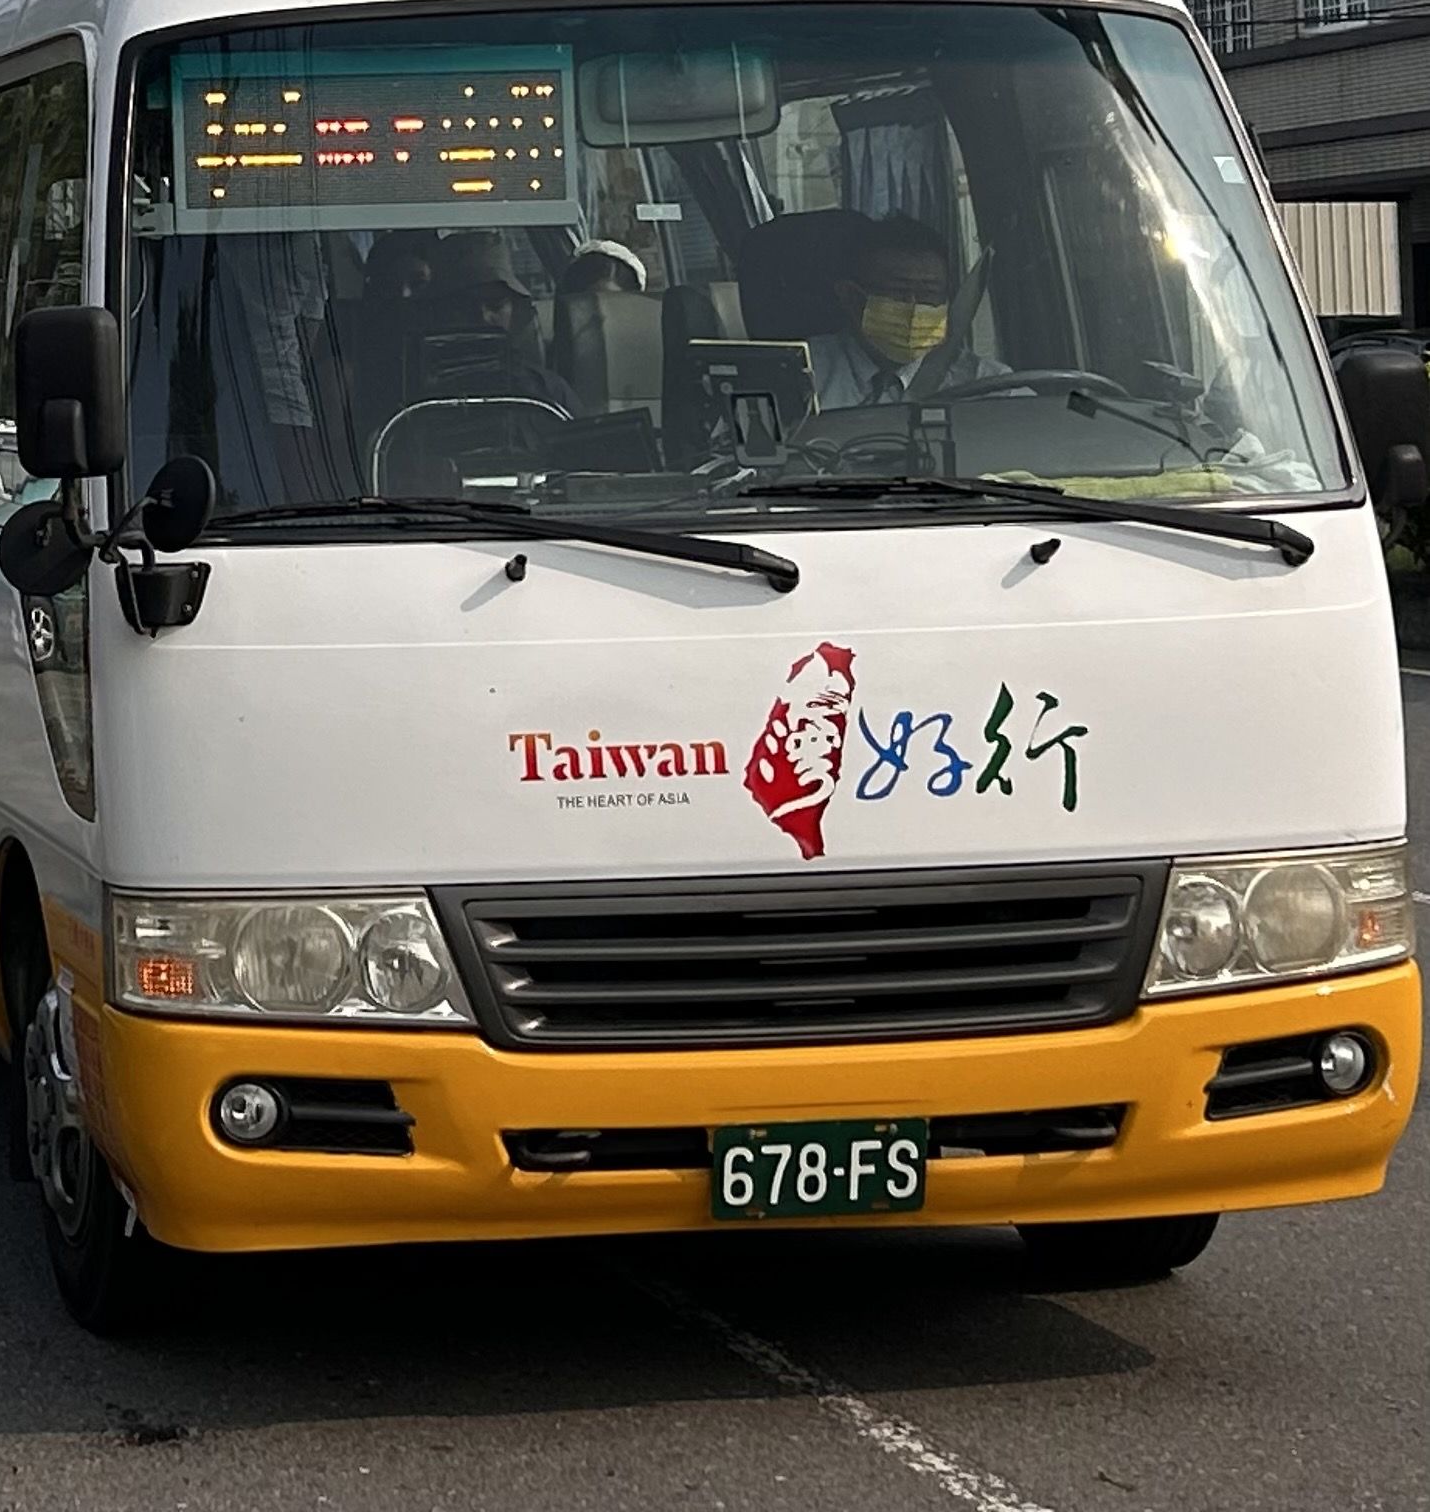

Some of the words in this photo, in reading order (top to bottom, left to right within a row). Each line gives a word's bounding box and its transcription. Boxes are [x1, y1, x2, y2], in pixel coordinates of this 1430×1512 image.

[509, 728, 729, 784] Taiwan
[856, 682, 1089, 813] 好行
[556, 795, 585, 809] THE
[587, 794, 635, 808] HEART
[637, 793, 655, 807] OF
[657, 792, 691, 807] ASIA
[723, 1139, 919, 1206] 678-FS
